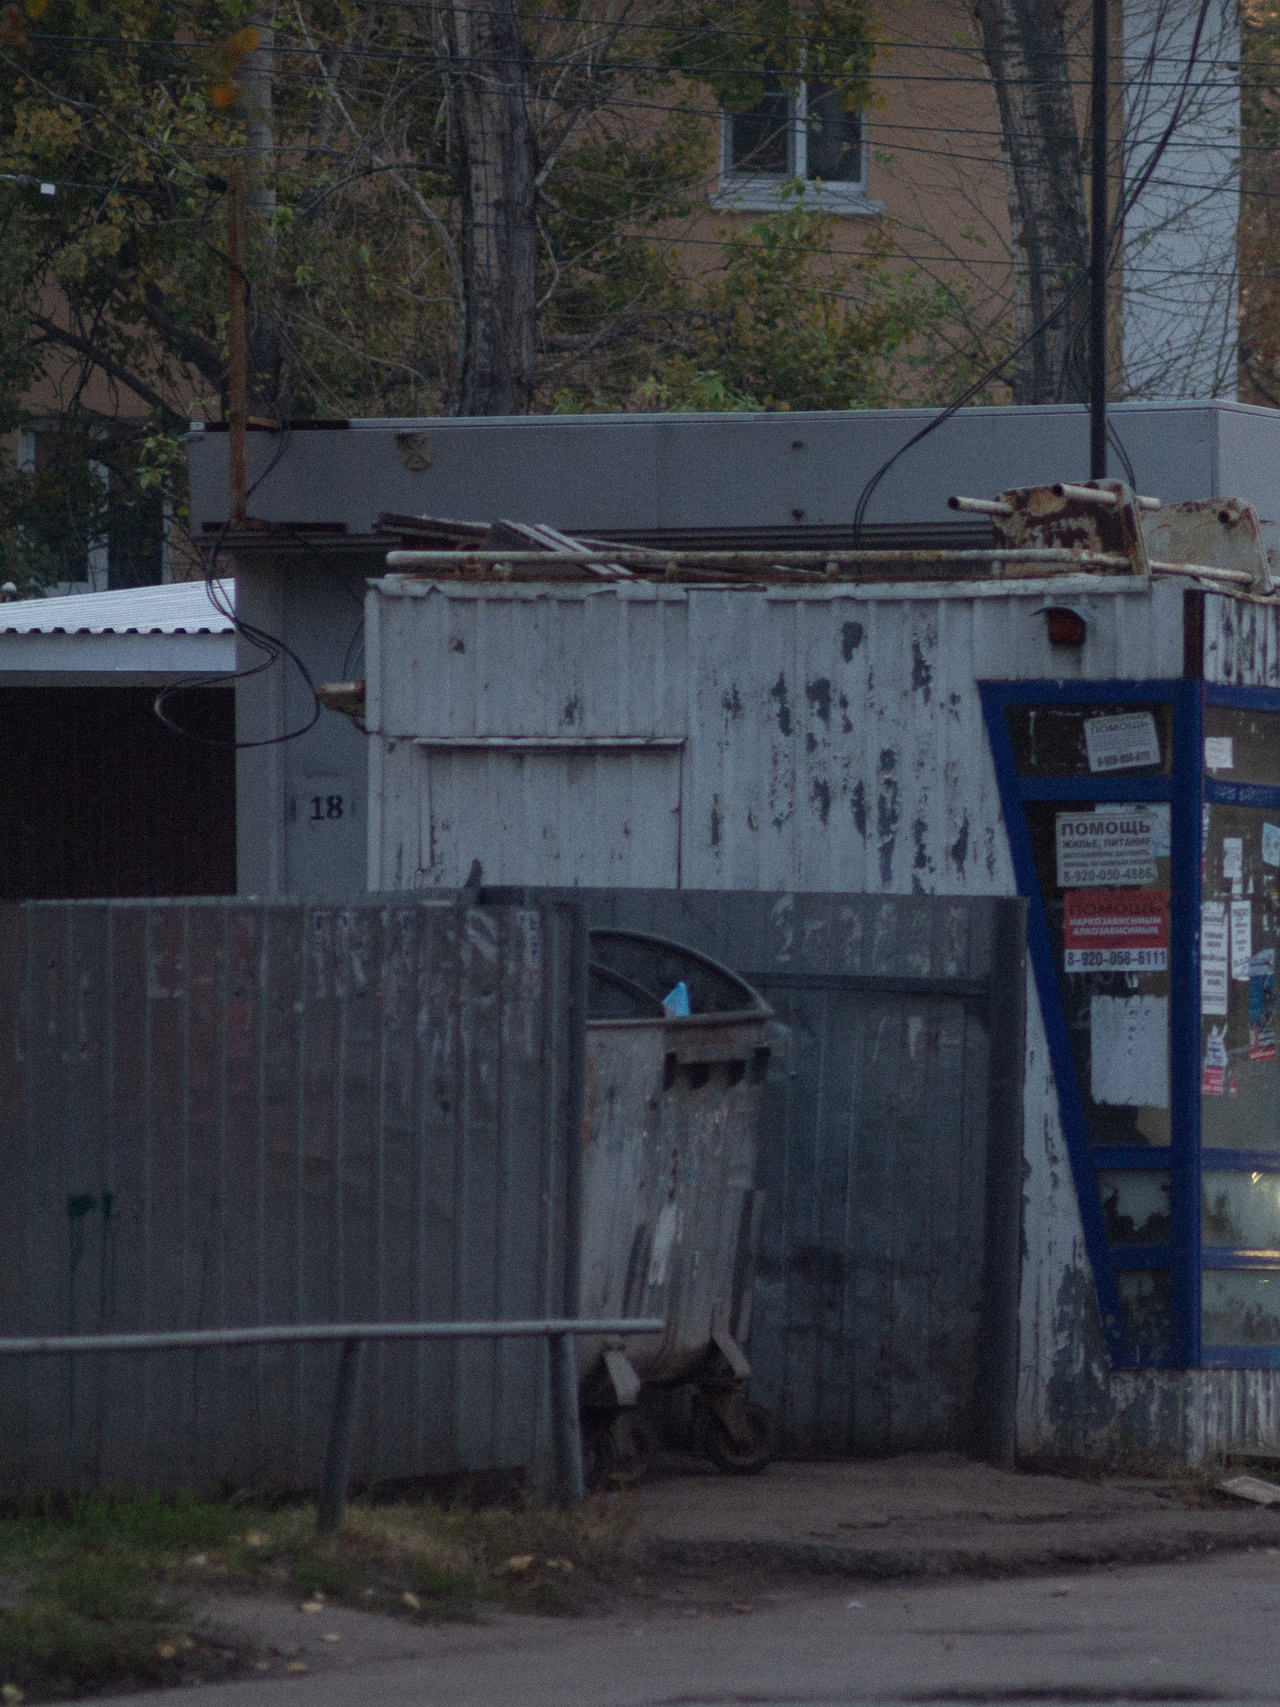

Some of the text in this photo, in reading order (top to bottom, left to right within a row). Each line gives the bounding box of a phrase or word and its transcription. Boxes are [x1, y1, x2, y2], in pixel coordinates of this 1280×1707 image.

[1090, 721, 1149, 734] ПОМОЩЬ
[310, 795, 344, 821] 18
[1060, 821, 1151, 836] ПОМОЩЬ
[1069, 917, 1161, 926] НАРКОЗАВИСИМЫМ
[1072, 926, 1159, 935] АЛКОЗАВИСИМЫМ
